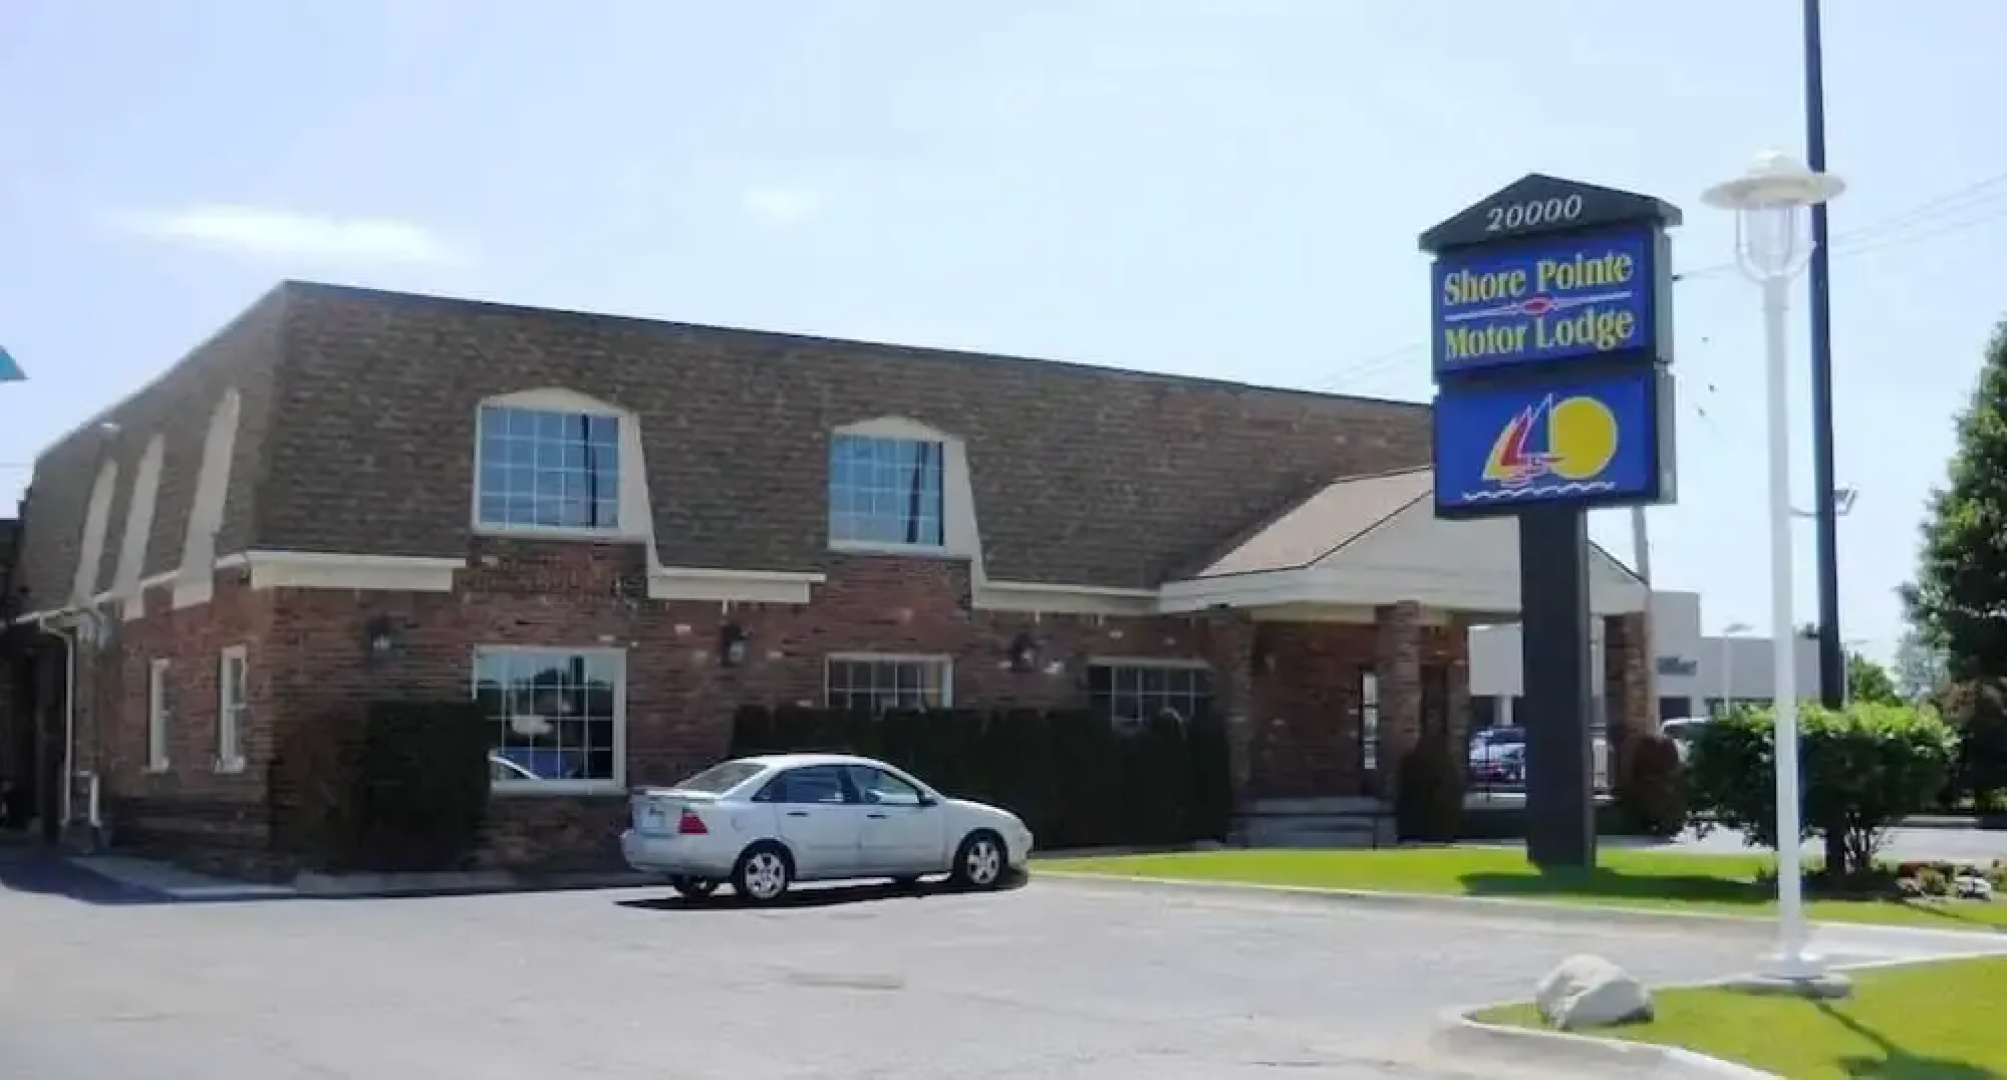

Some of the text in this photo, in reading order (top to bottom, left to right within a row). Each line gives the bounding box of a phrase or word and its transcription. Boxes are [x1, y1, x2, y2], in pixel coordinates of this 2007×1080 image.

[1486, 195, 1582, 231] 20000
[1445, 251, 1633, 304] Shore Pointe
[1445, 307, 1634, 360] Motor Lodge
